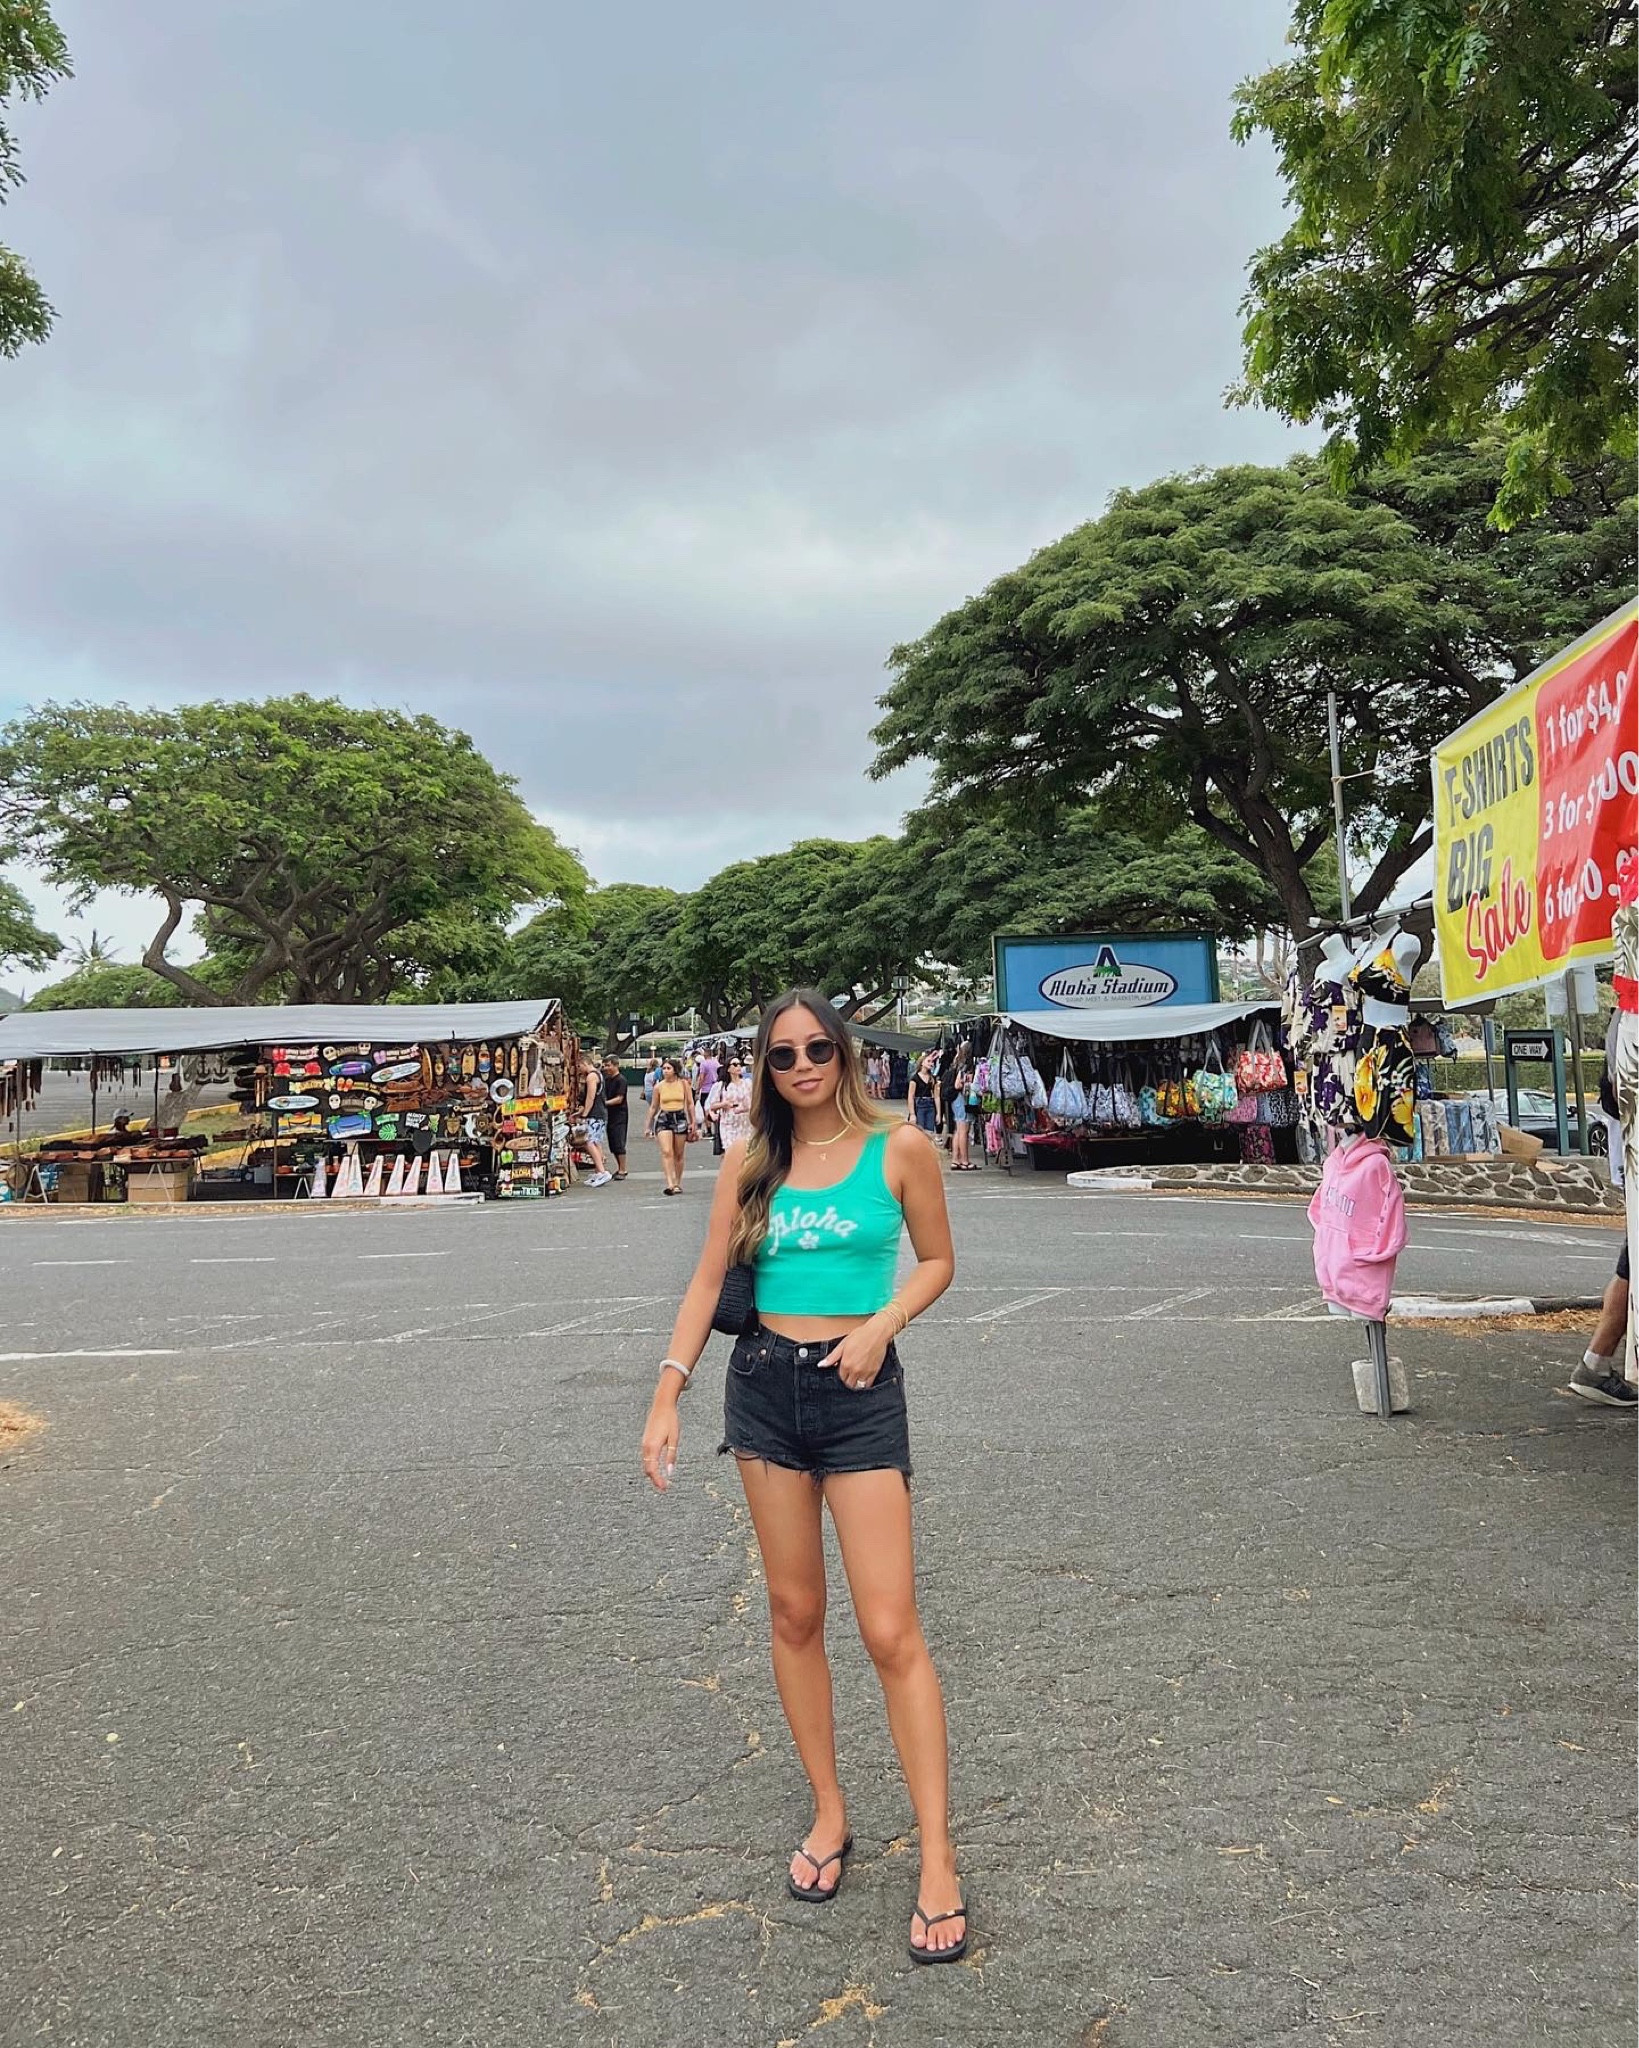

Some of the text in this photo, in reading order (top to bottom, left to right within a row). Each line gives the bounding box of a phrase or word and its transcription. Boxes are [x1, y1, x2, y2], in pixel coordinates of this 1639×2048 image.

[1546, 715, 1555, 754] 1
[1559, 704, 1584, 747] for
[1444, 715, 1534, 828] T-SHIRTS
[1543, 800, 1554, 840] 3
[1558, 791, 1584, 834] for
[1447, 823, 1494, 914] BIG
[1465, 855, 1532, 981] Sale
[1545, 883, 1554, 924] 6
[1556, 876, 1578, 920] for
[1049, 978, 1169, 996] Aloha Stadium
[1513, 1045, 1542, 1055] ONE WAY
[767, 1206, 858, 1256] Aloha
